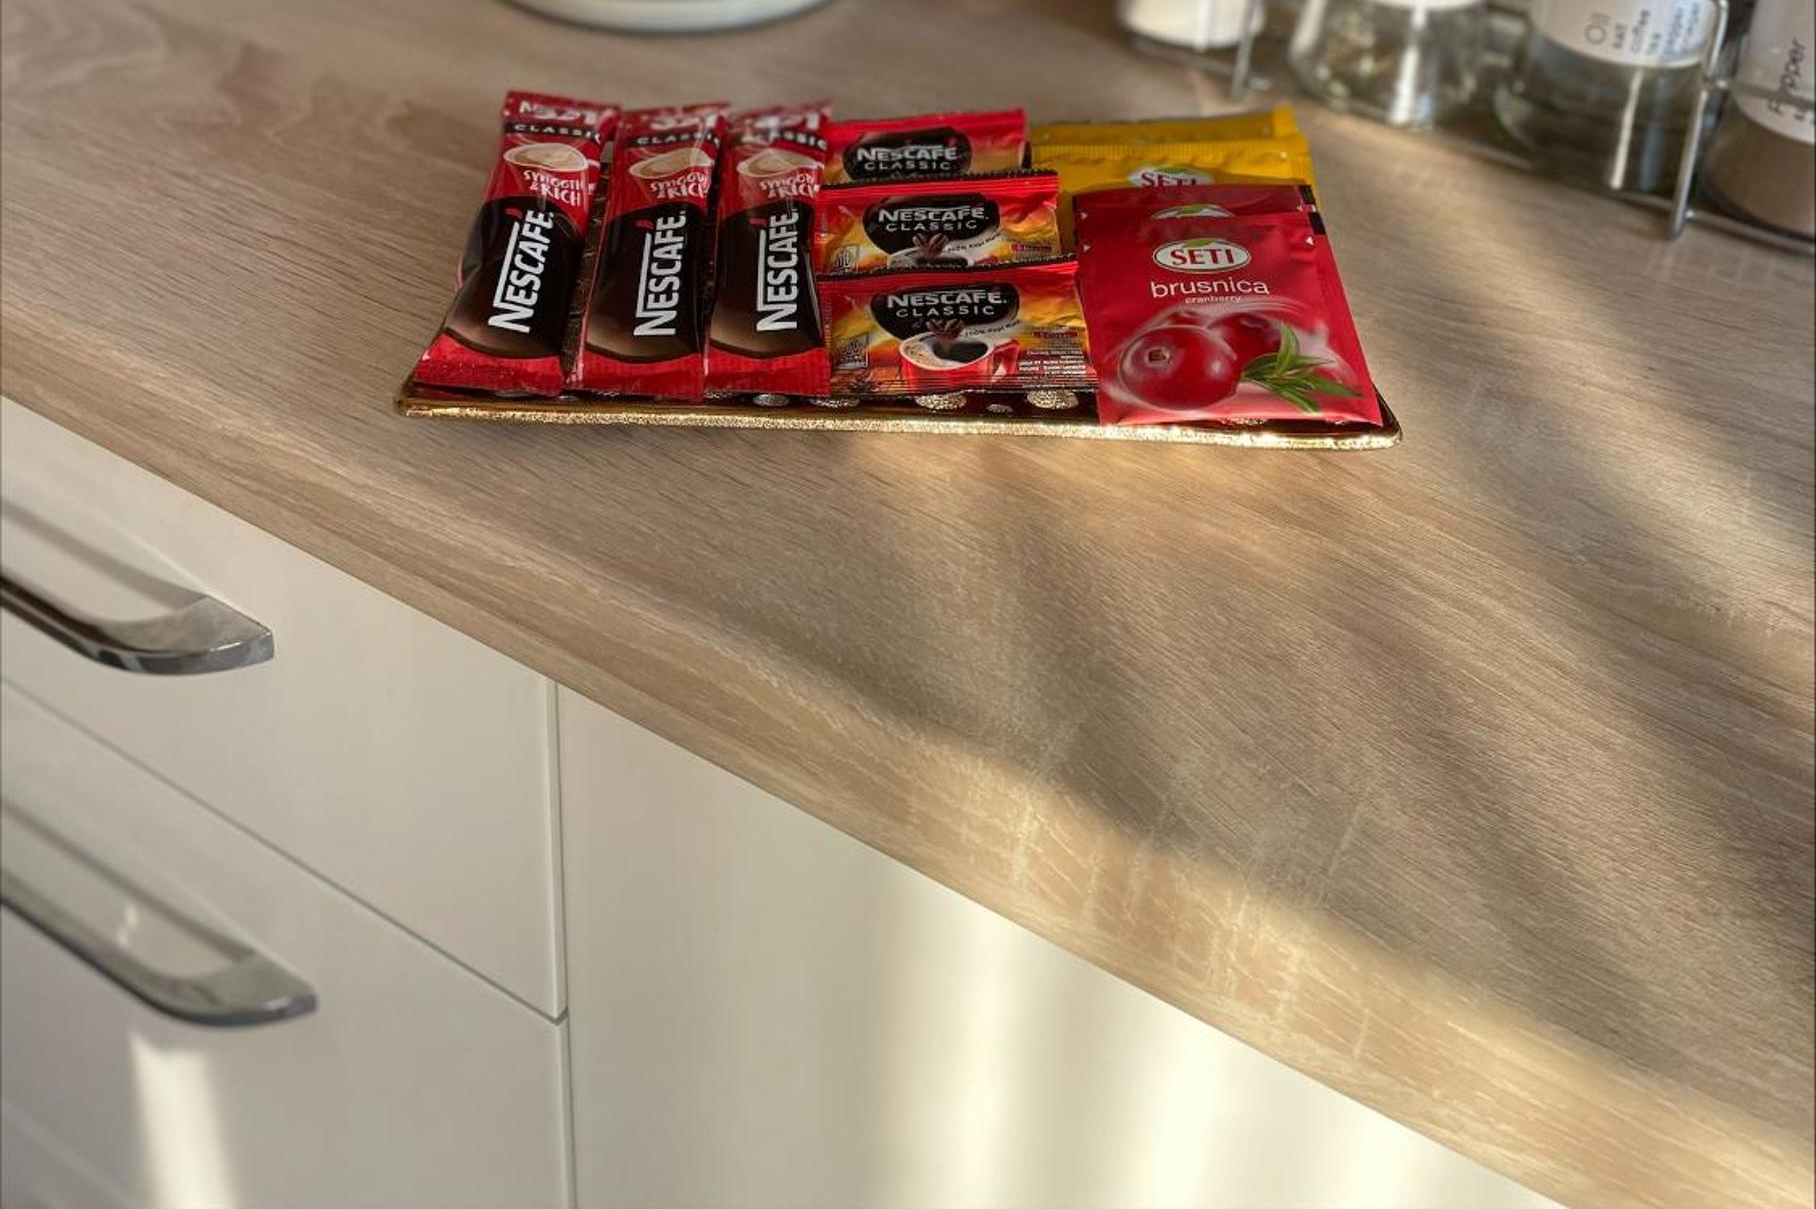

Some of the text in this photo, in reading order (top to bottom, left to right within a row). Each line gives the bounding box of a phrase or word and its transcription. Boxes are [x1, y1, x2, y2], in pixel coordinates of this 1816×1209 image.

[1767, 38, 1807, 116] Ppper
[864, 160, 952, 170] CLASSIC
[540, 183, 581, 207] RICH
[886, 220, 978, 232] CLASSIC
[1170, 248, 1235, 265] SETI
[1150, 276, 1270, 298] brusnica
[1184, 295, 1242, 305] cranberry
[896, 305, 995, 318] CLASSIC
